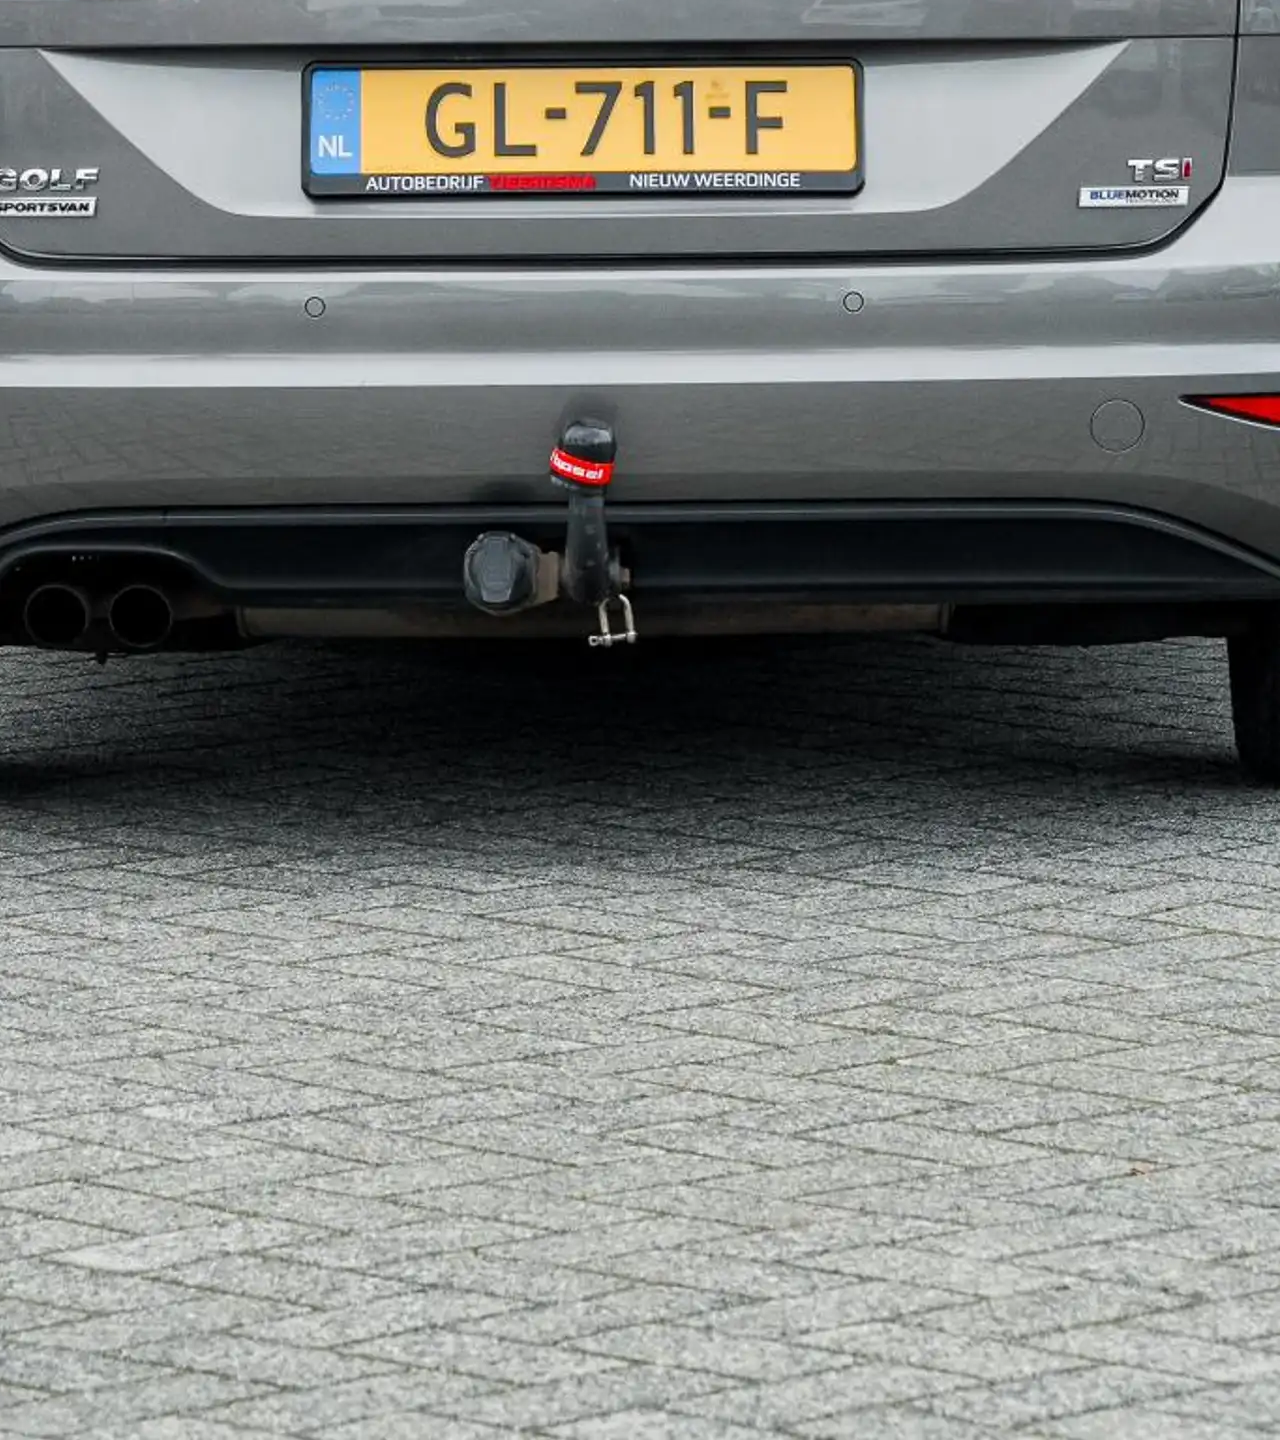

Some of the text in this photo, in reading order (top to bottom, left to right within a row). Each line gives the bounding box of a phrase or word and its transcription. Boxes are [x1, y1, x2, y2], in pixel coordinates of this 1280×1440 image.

[424, 80, 788, 158] GL-711-F
[318, 135, 353, 158] NL
[365, 175, 484, 192] AUTOBEDRIJF
[629, 172, 692, 189] NIEUW
[694, 171, 801, 188] WEERDINGE
[1089, 188, 1180, 201] BLUEMOTION
